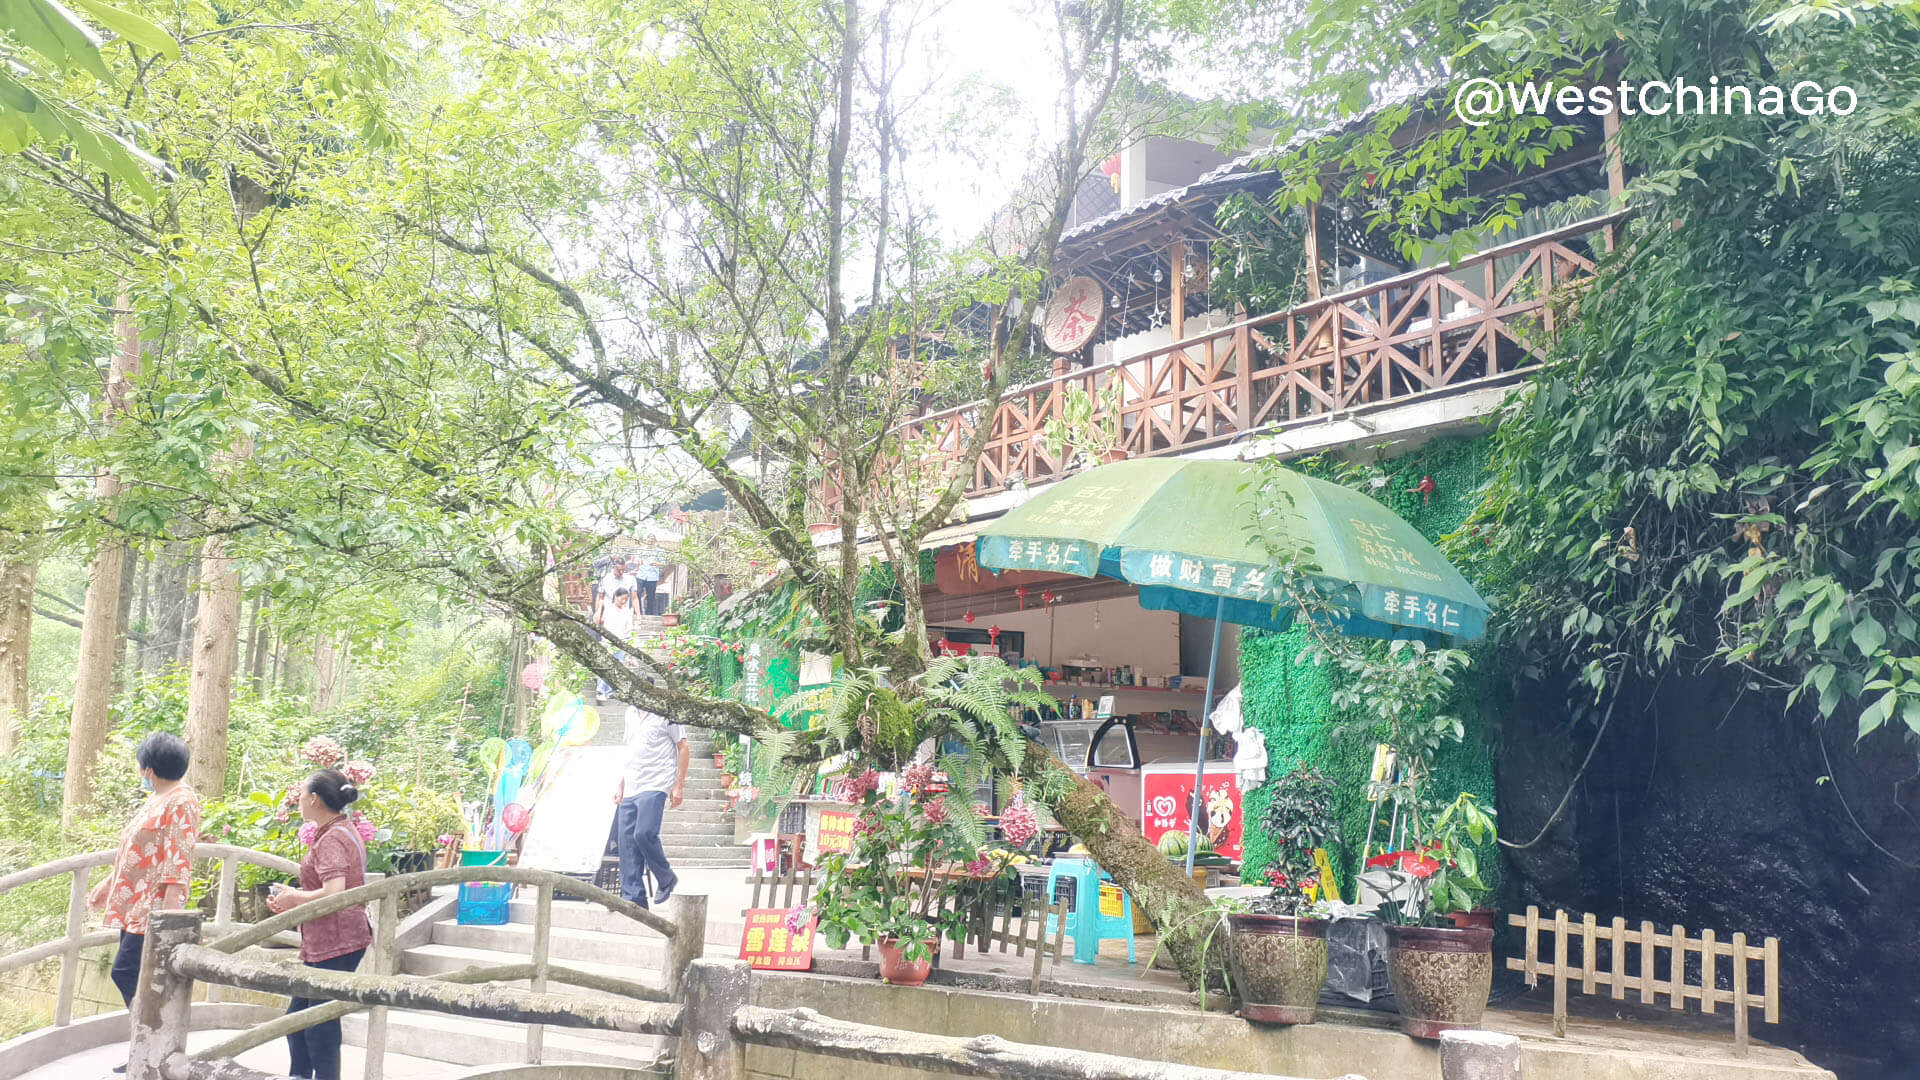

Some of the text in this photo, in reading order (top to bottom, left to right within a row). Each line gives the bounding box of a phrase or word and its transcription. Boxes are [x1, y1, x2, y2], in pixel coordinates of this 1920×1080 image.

[1055, 288, 1097, 342] 茶
[1007, 539, 1081, 567] 牵手名仁
[1383, 589, 1462, 629] 牵手名仁
[744, 642, 762, 703] 泉水豆花
